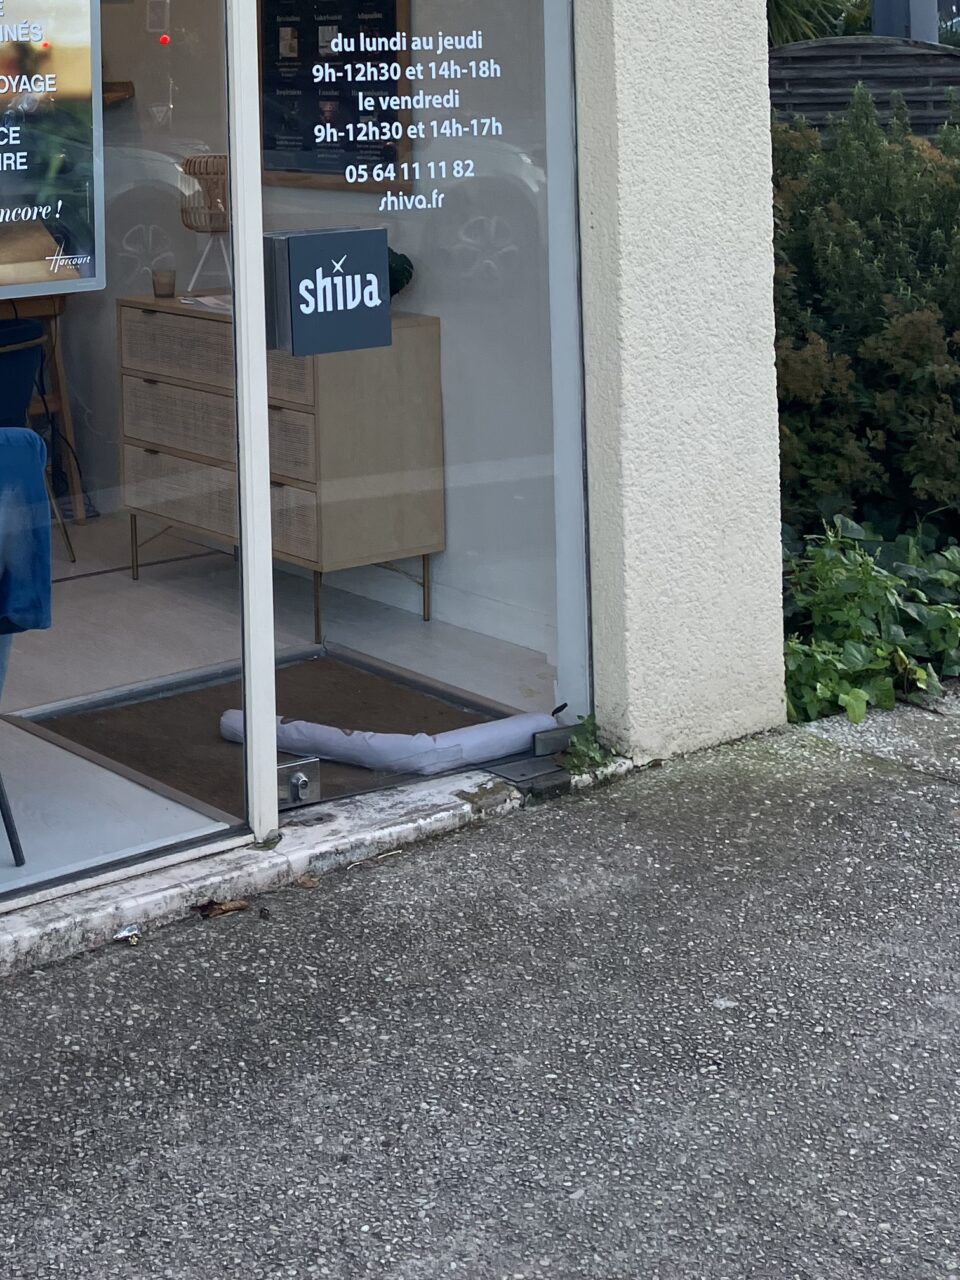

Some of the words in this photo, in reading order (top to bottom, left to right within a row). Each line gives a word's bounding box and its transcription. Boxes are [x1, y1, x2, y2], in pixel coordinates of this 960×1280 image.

[330, 34, 356, 52] du
[359, 32, 407, 51] lundi
[411, 37, 434, 50] au
[437, 32, 483, 55] jeudi
[312, 62, 401, 83] 9h-12h30
[405, 63, 424, 79] et
[428, 60, 501, 79] 14h-18h
[358, 92, 376, 111] le
[379, 90, 460, 110] vendredi
[314, 122, 403, 143] 9h-12h30
[407, 123, 425, 139] et
[430, 118, 503, 139] 14h-17h
[345, 165, 371, 182] 05
[373, 163, 396, 181] 64
[401, 162, 422, 180] 11
[427, 161, 448, 179] 11
[452, 160, 475, 178] 82
[55, 199, 63, 220] !
[379, 190, 445, 212] shiva.fr
[45, 239, 91, 273] Harcourt
[299, 267, 381, 315] shiva
